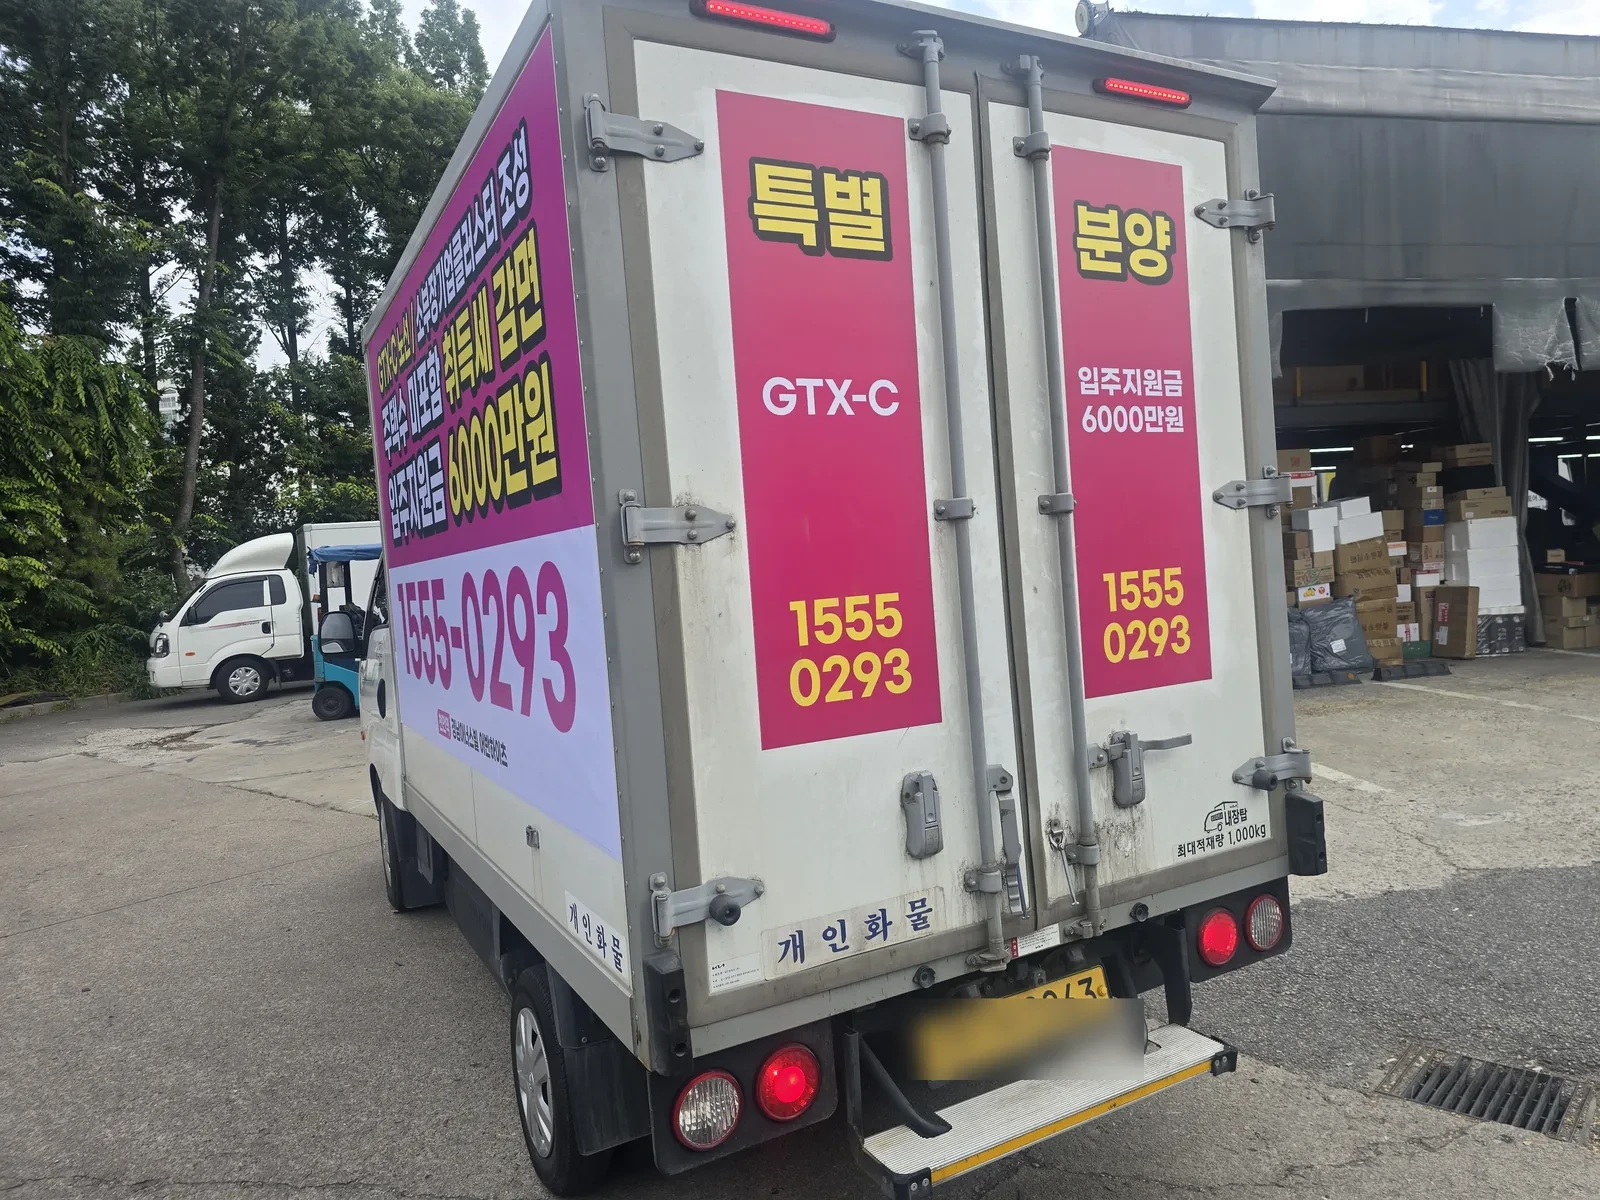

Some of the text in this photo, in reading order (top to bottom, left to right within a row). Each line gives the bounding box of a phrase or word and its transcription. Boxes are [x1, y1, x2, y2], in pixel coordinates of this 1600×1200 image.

[752, 163, 886, 253] 특별
[377, 125, 530, 393] GTX-C 노선 소부장기업클러스터 조성
[1076, 204, 1172, 279] 분양
[381, 226, 543, 462] 주택수 미포함 취득세 감면
[762, 376, 900, 417] GTX-C
[1077, 366, 1183, 397] 입주지원금
[1081, 405, 1185, 433] 6000만원
[388, 360, 559, 546] 입주지원금 6000만원
[1102, 567, 1184, 612] 1555
[396, 559, 577, 734] 1555-0293
[789, 592, 903, 647] 1555
[1103, 614, 1191, 664] 0293
[789, 647, 912, 707] 0293
[479, 731, 508, 767] 어반하이츠
[1177, 824, 1266, 858] 최대적재량 1,000kg
[1224, 807, 1247, 826] 내장탑
[568, 902, 623, 973] 개인화물
[778, 896, 934, 963] 개인화물
